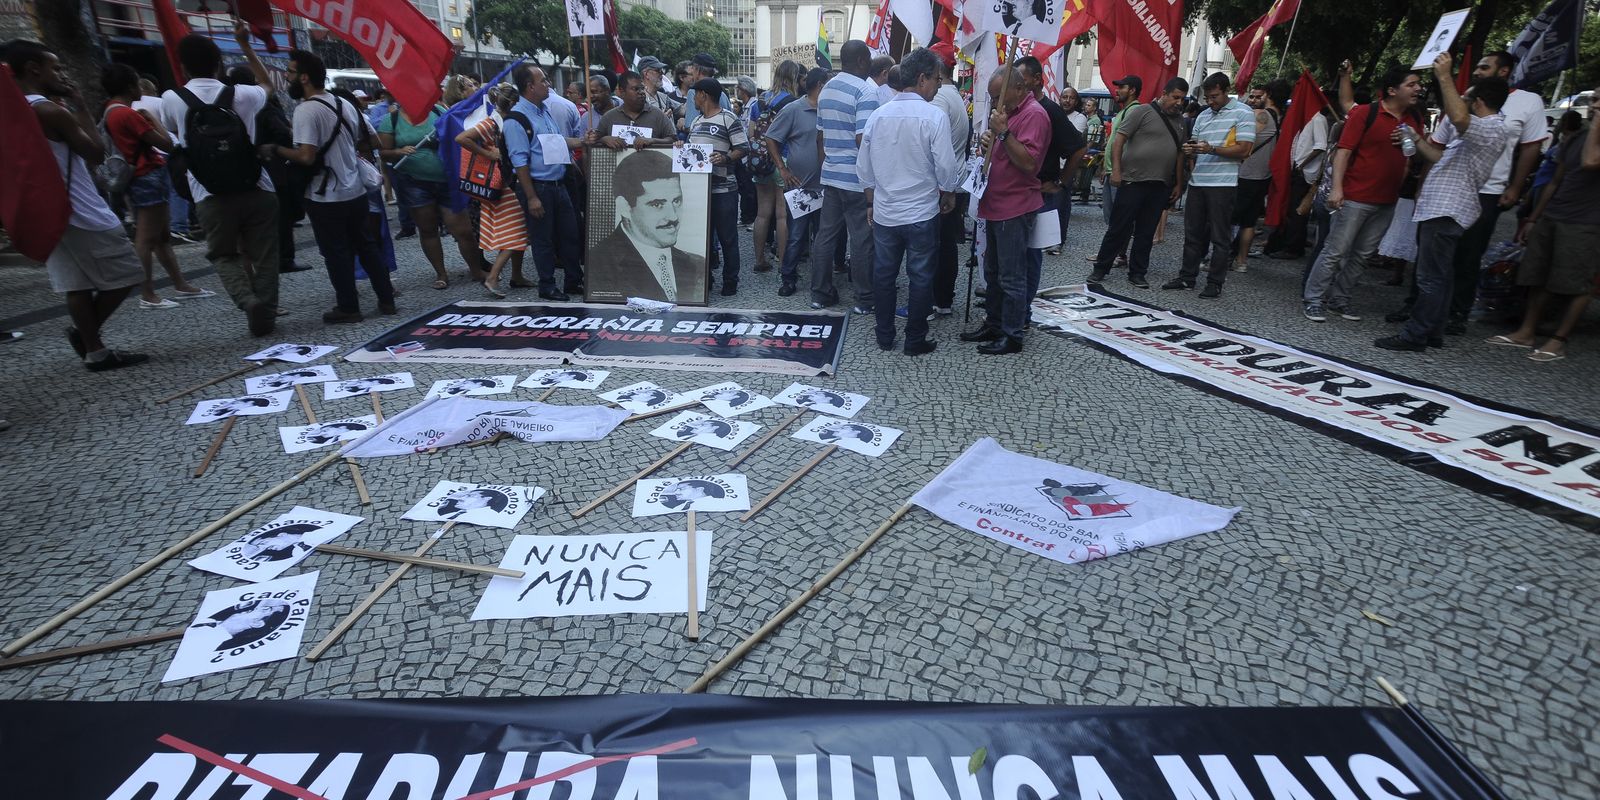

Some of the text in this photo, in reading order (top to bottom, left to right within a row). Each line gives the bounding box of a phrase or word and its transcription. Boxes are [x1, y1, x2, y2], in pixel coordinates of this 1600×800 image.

[773, 44, 816, 58] QUEREMOS
[460, 181, 492, 198] TOMMY
[411, 327, 823, 349] DITADURA NUNCA MAIS
[671, 320, 832, 339] SEMPRE!
[1345, 410, 1459, 444] DOS
[1463, 448, 1552, 476] 50
[1048, 519, 1074, 532] DOS
[1049, 529, 1068, 539] DO
[523, 538, 681, 566] NUNCA
[516, 564, 653, 607] MAIS
[210, 598, 309, 664] Palhano?
